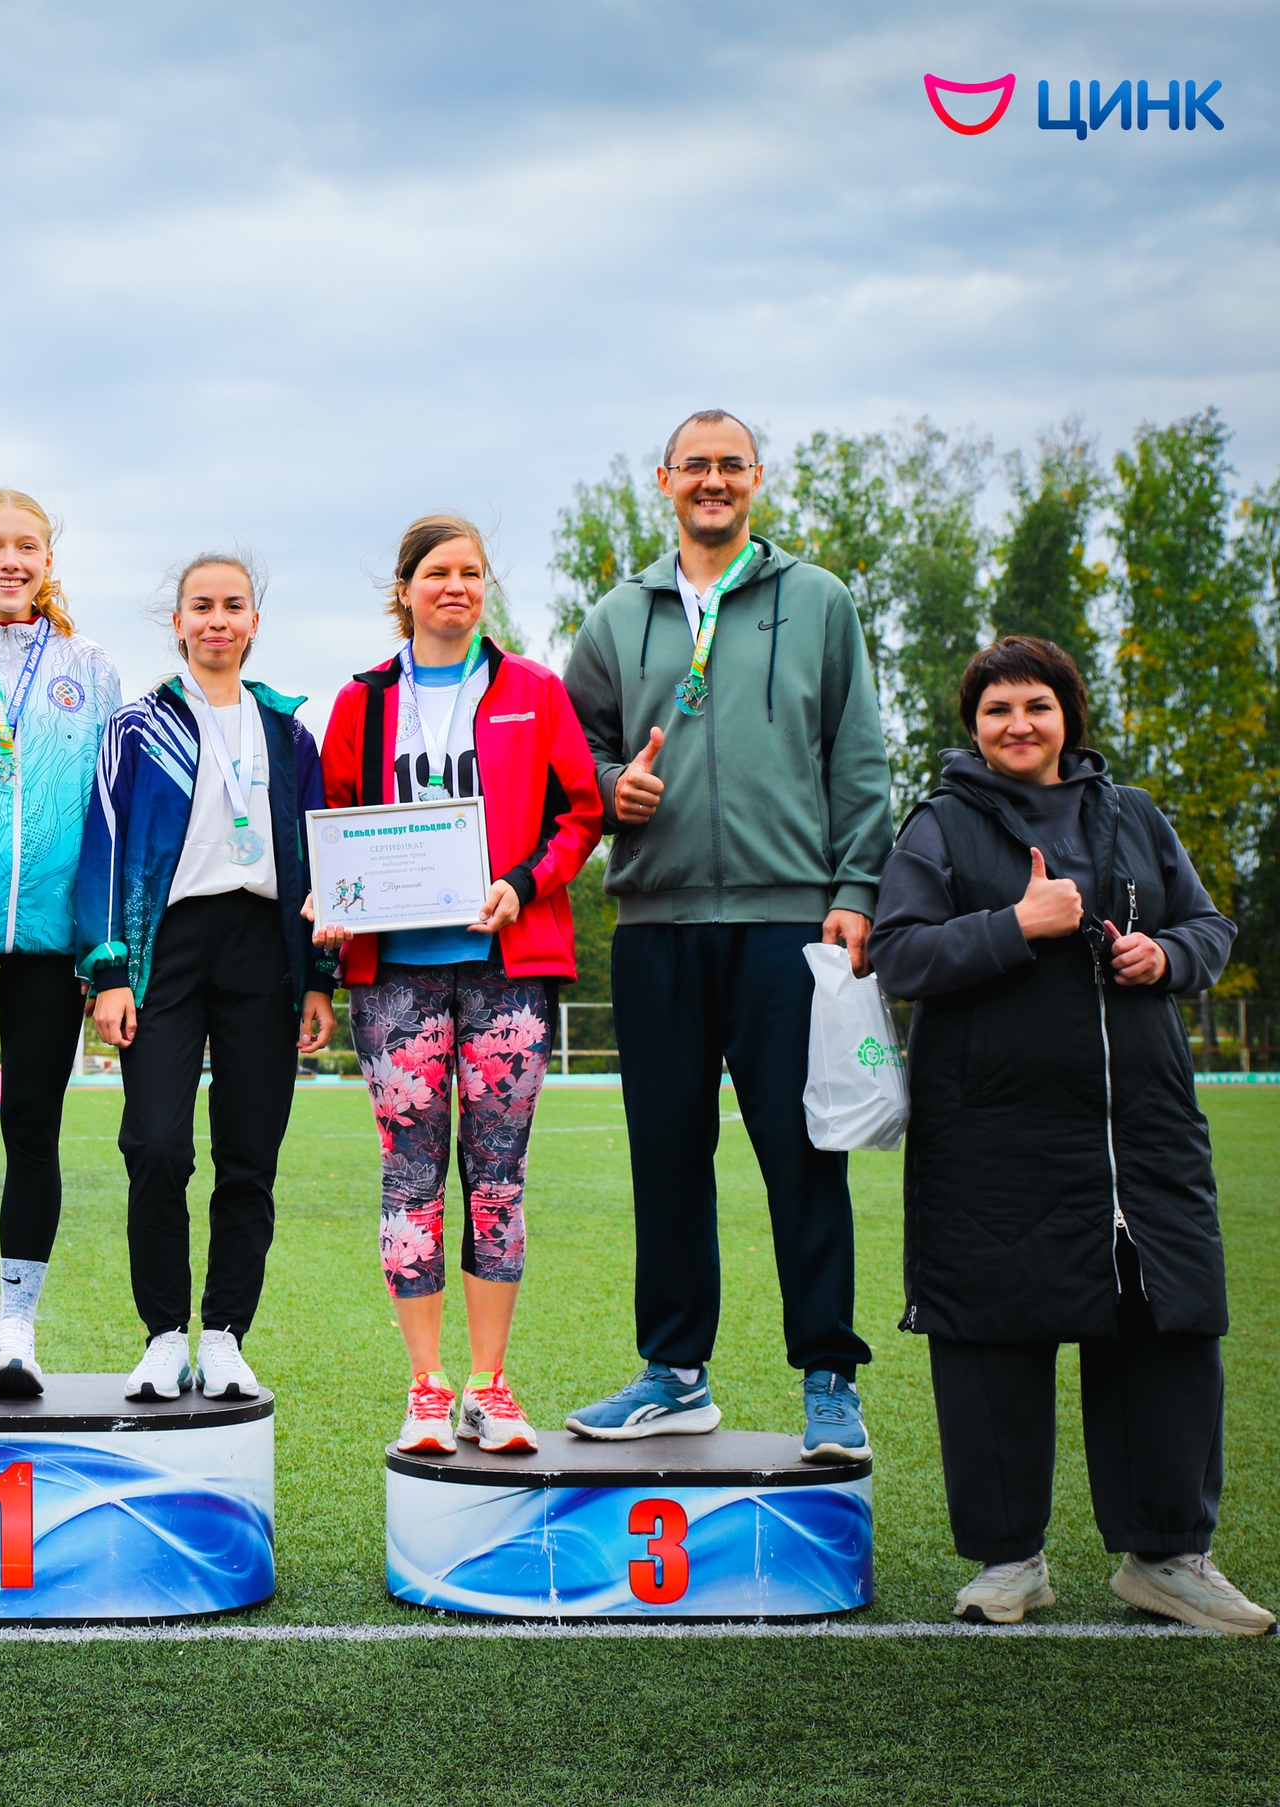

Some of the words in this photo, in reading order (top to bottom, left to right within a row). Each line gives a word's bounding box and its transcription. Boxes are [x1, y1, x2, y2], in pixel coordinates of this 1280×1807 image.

[27, 643, 41, 671] ВОКРУГ
[12, 670, 32, 707] КОЛЬЦОВО
[343, 828, 376, 839] Кольцо
[377, 825, 407, 836] вокруг
[408, 822, 452, 833] Кольцово
[369, 841, 424, 853] СЕРТИФИКАТ
[378, 853, 408, 861] получение
[364, 868, 408, 876] корпоративной
[409, 865, 435, 873] эстафеты
[628, 1498, 689, 1604] 3
